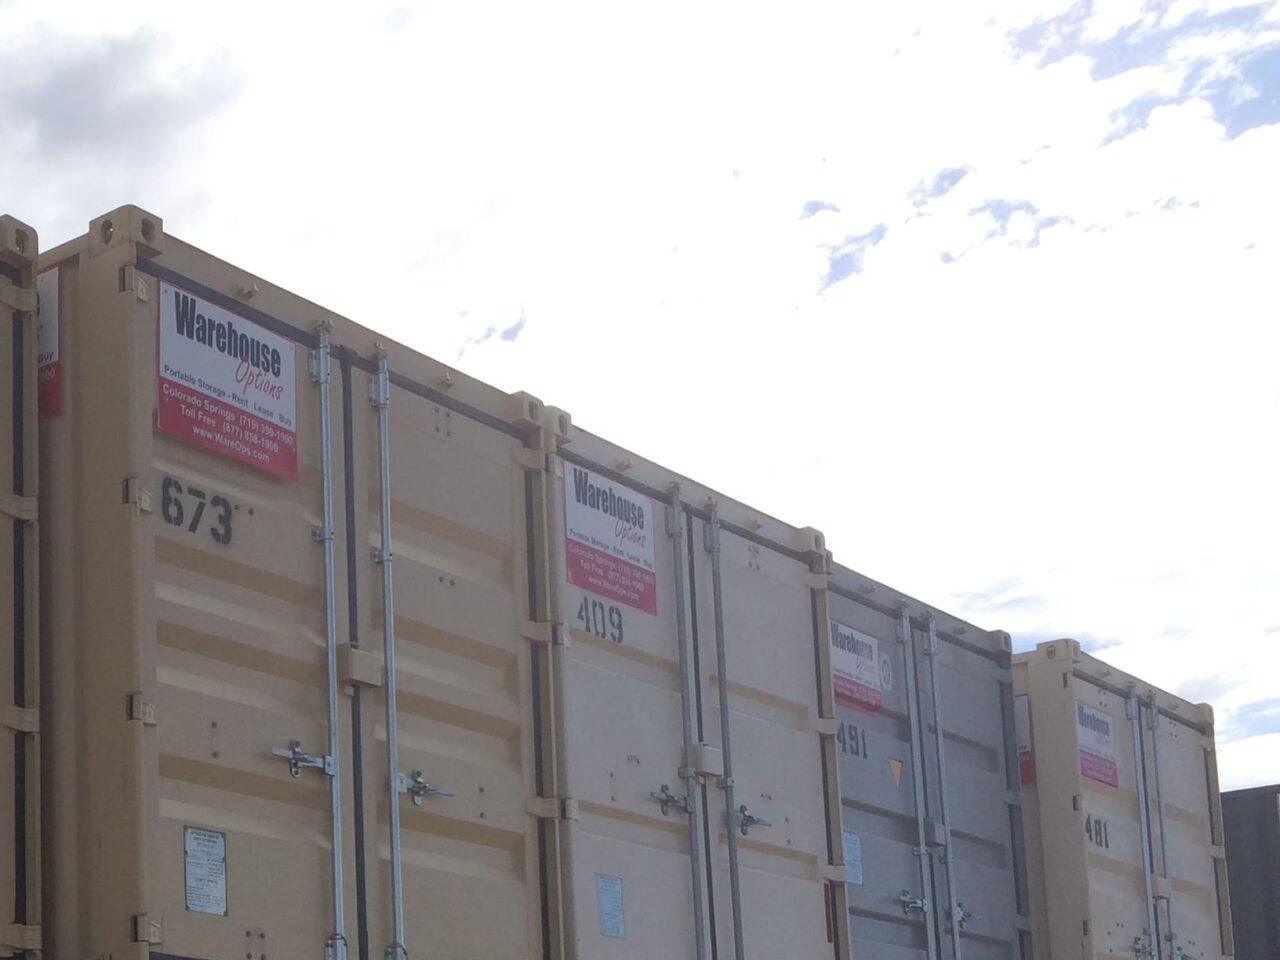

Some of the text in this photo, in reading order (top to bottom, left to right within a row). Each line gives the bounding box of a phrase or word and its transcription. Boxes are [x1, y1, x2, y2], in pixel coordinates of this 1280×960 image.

[174, 291, 281, 378] Warehouse
[164, 365, 196, 385] Portable
[198, 379, 226, 398] Storage
[235, 359, 283, 400] Options
[162, 384, 202, 407] Colorado
[204, 399, 236, 422] Springs
[180, 404, 196, 417] Toll
[162, 477, 233, 545] 673
[573, 467, 644, 530] Warehouse
[577, 596, 624, 644] 409
